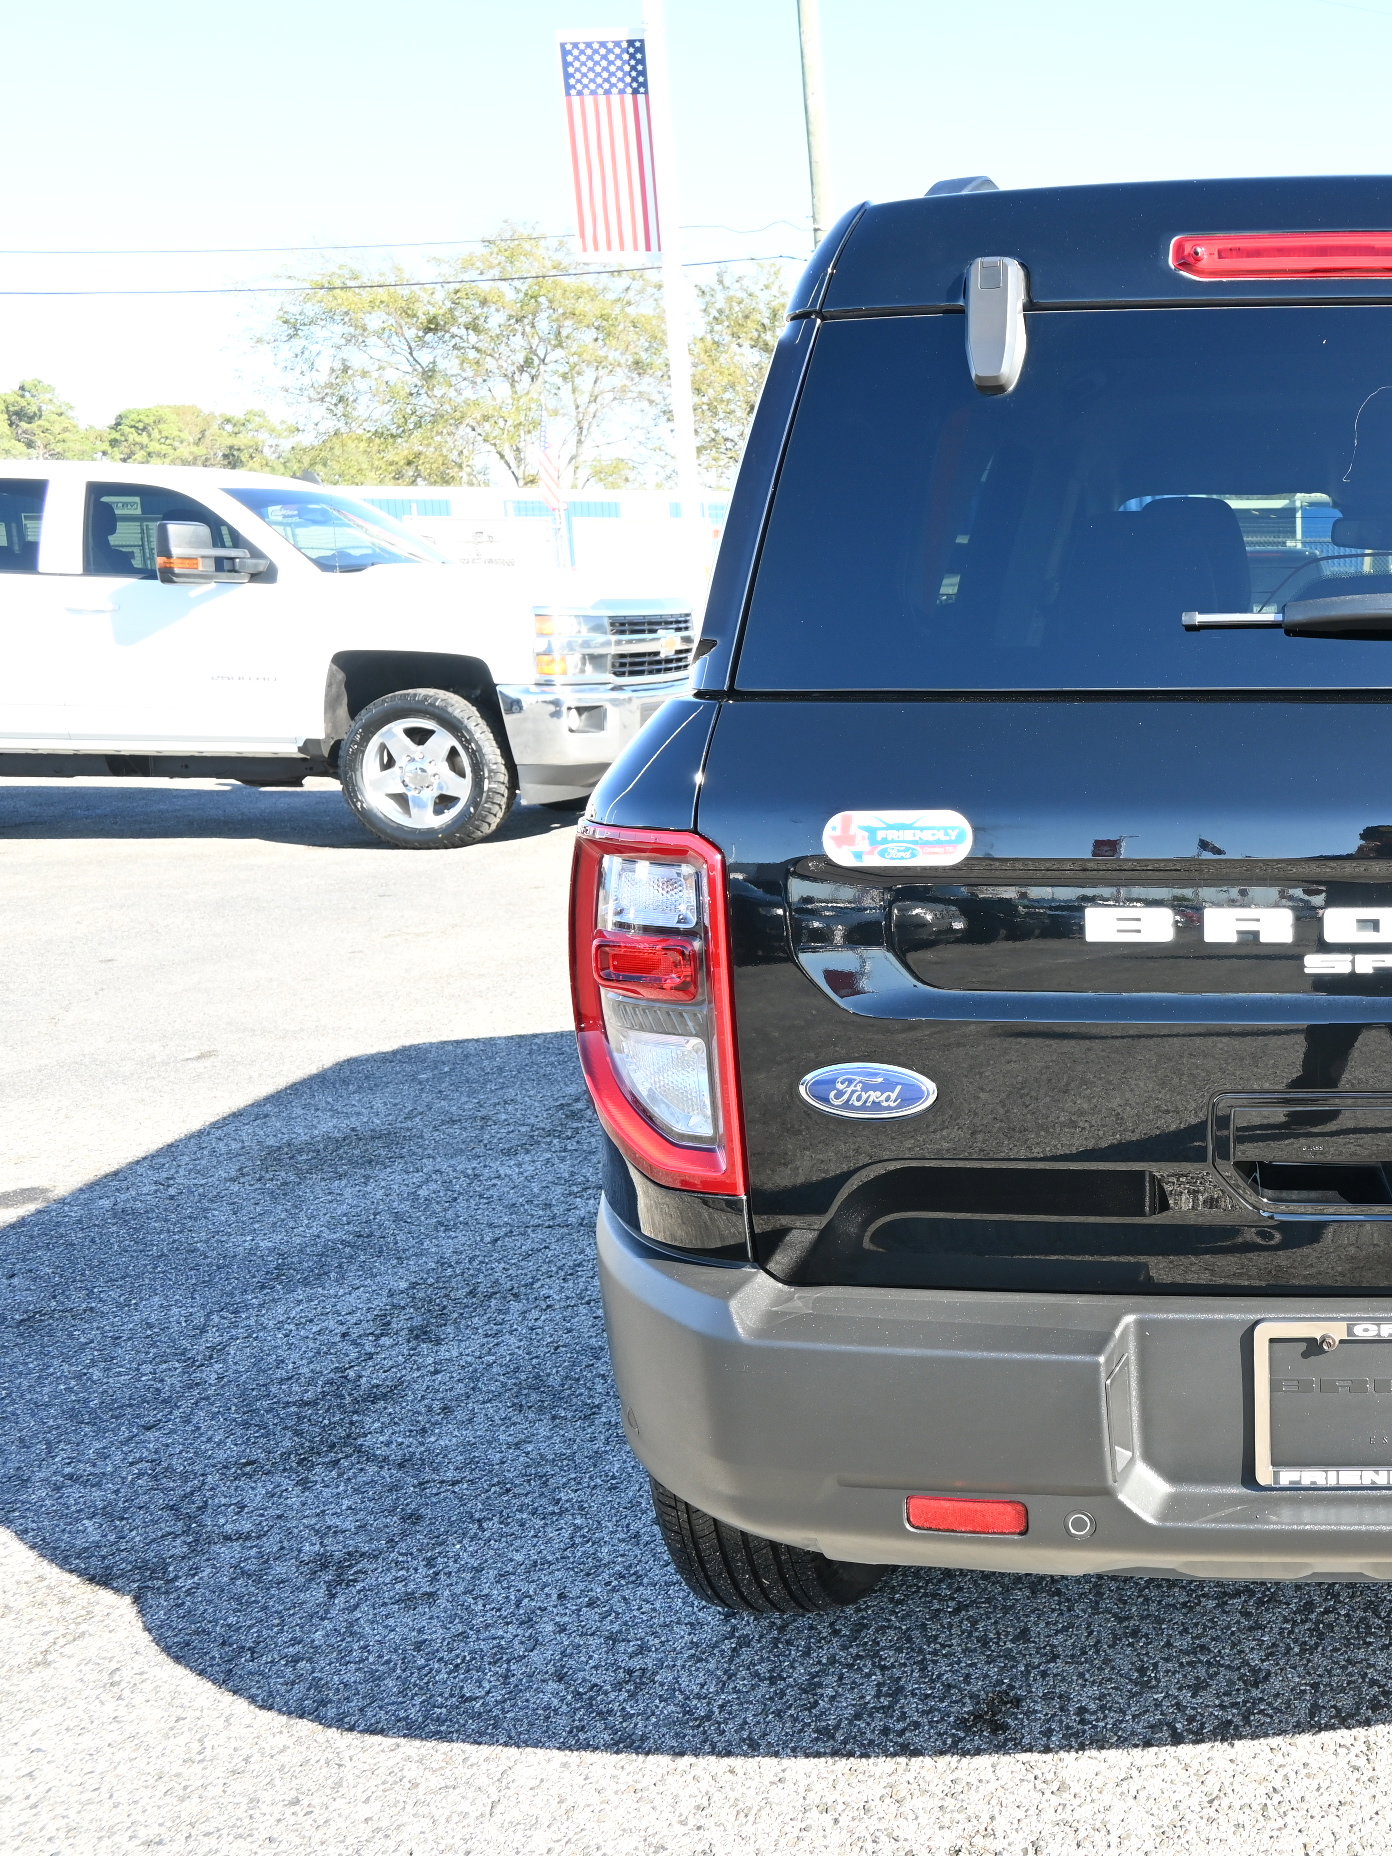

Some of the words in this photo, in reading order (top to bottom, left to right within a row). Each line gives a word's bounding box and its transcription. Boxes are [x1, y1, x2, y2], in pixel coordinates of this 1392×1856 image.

[877, 829, 960, 841] FRIENDLY
[884, 845, 912, 859] Ford
[829, 1075, 902, 1107] Ford
